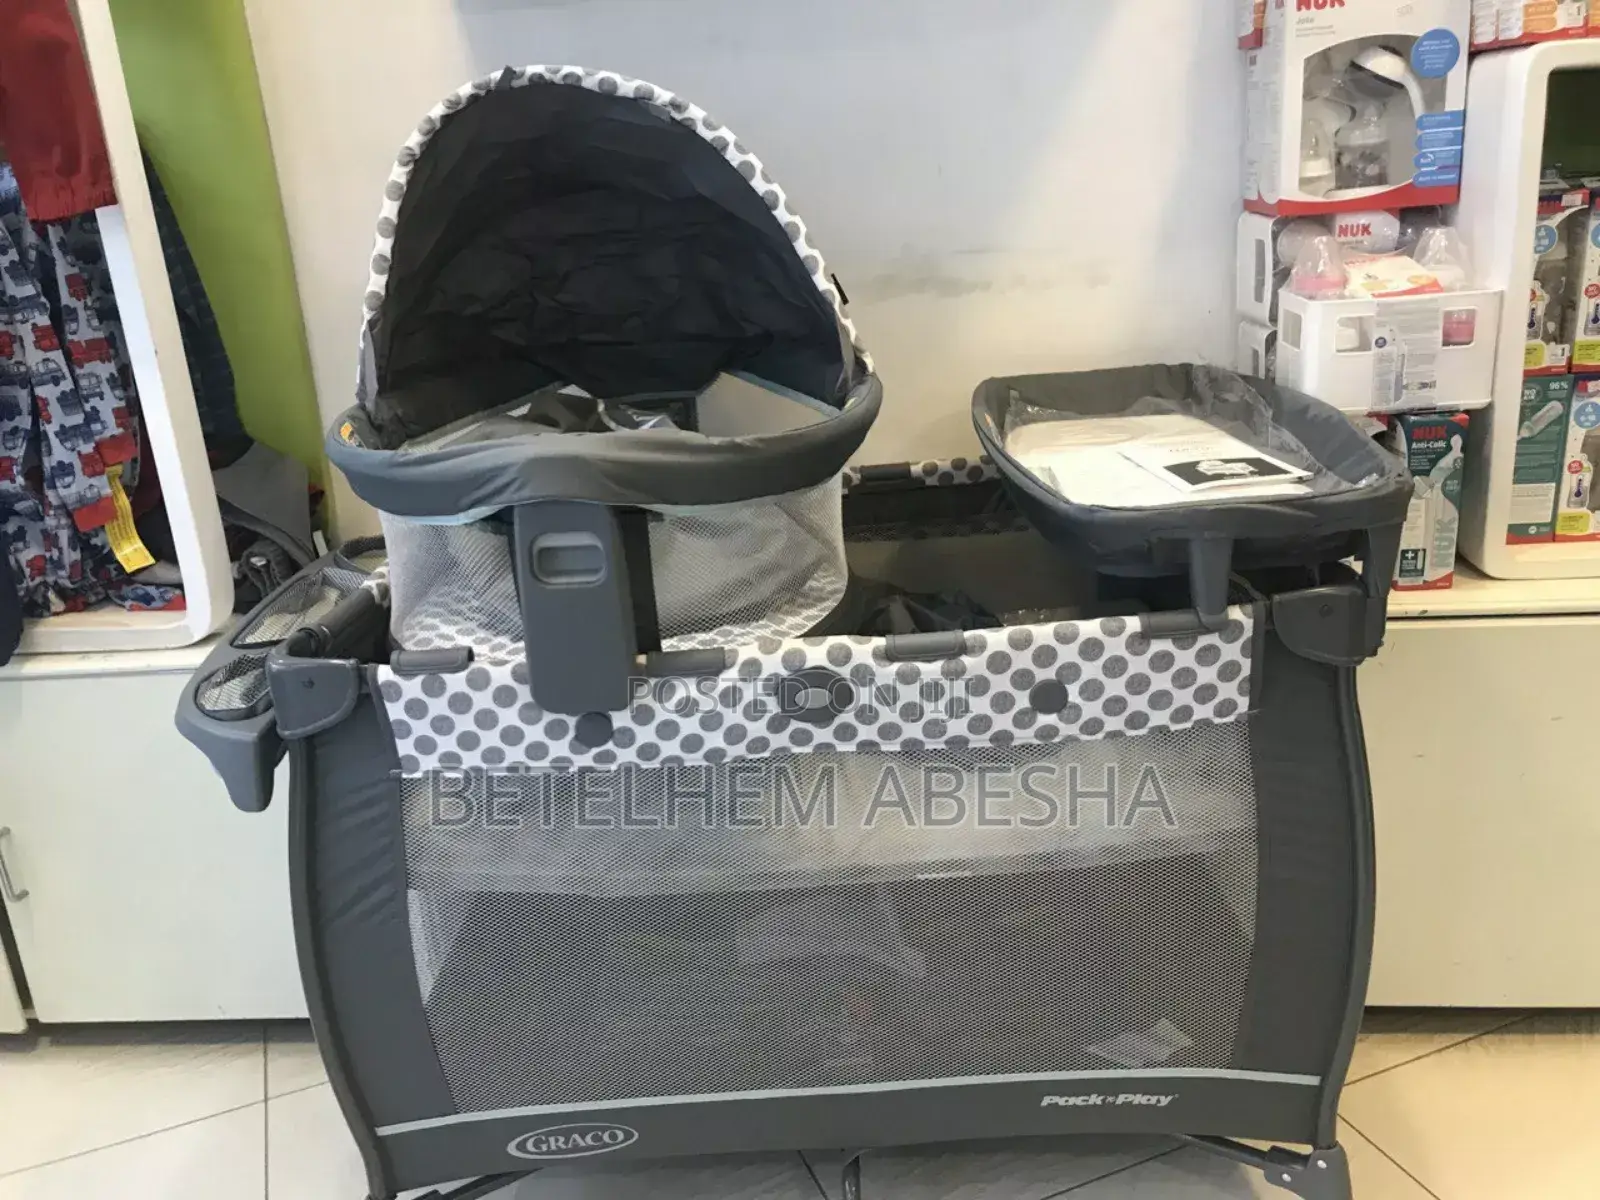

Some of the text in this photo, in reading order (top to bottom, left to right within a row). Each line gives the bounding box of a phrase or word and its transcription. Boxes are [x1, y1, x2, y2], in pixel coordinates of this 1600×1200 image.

[1337, 223, 1371, 237] NUK
[1412, 425, 1448, 439] NUK
[1040, 1094, 1105, 1106] Pack
[1115, 1093, 1174, 1107] Play
[525, 1129, 625, 1153] GRACO
